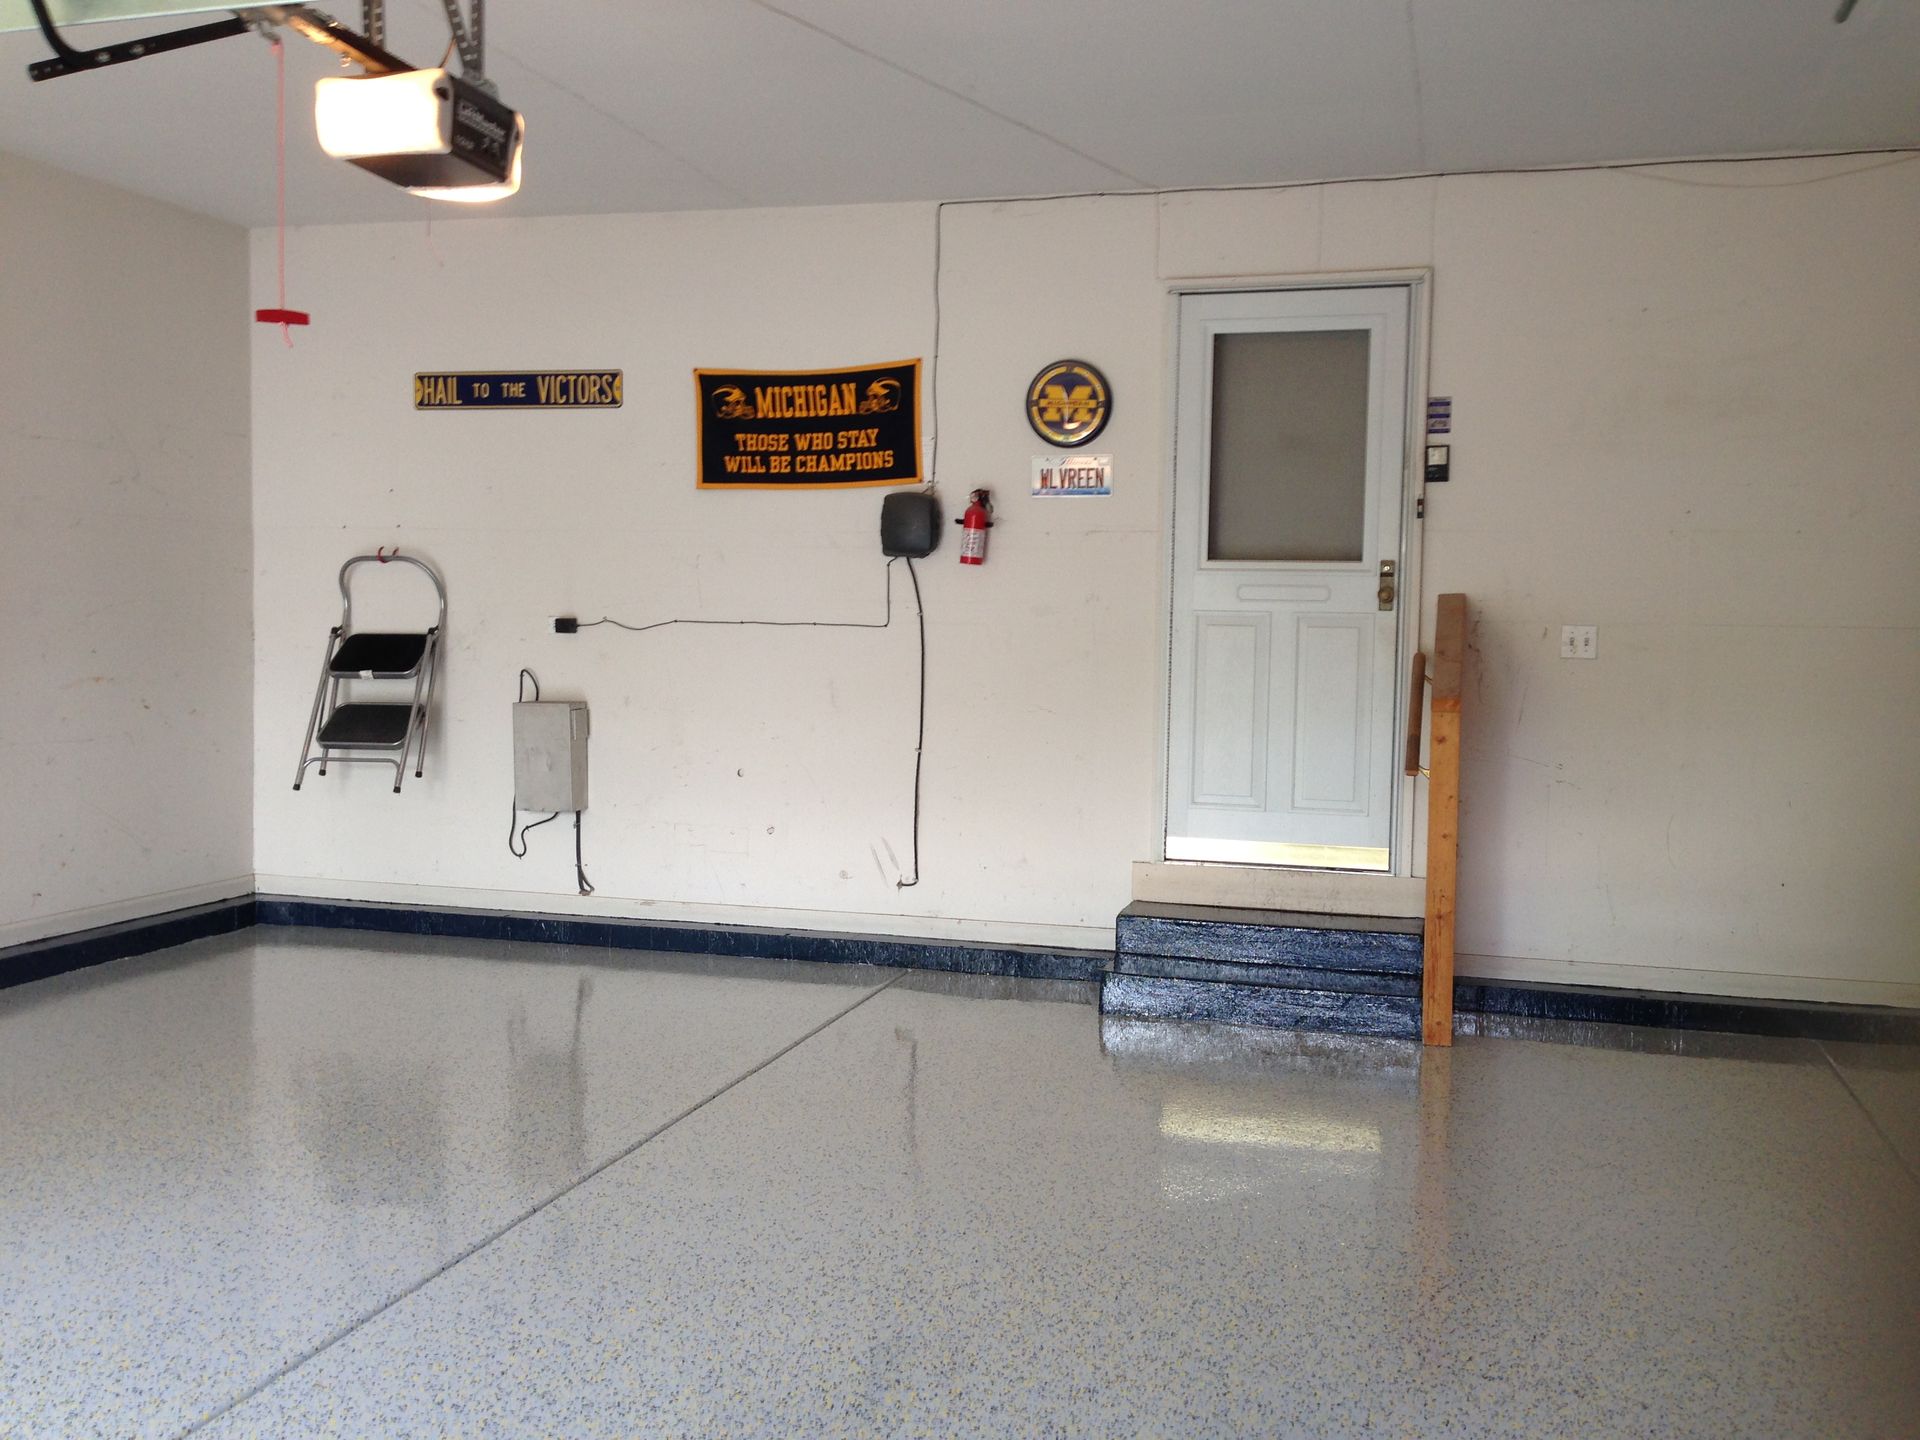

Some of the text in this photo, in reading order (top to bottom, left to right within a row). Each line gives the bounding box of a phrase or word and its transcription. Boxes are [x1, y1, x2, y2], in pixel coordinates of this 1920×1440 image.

[422, 374, 613, 405] HAIL TO THE VICTORS
[754, 382, 857, 419] MICHIGAN
[734, 428, 880, 451] THOSE WHO STAY
[723, 450, 895, 474] WILL BE CHAMPIONS
